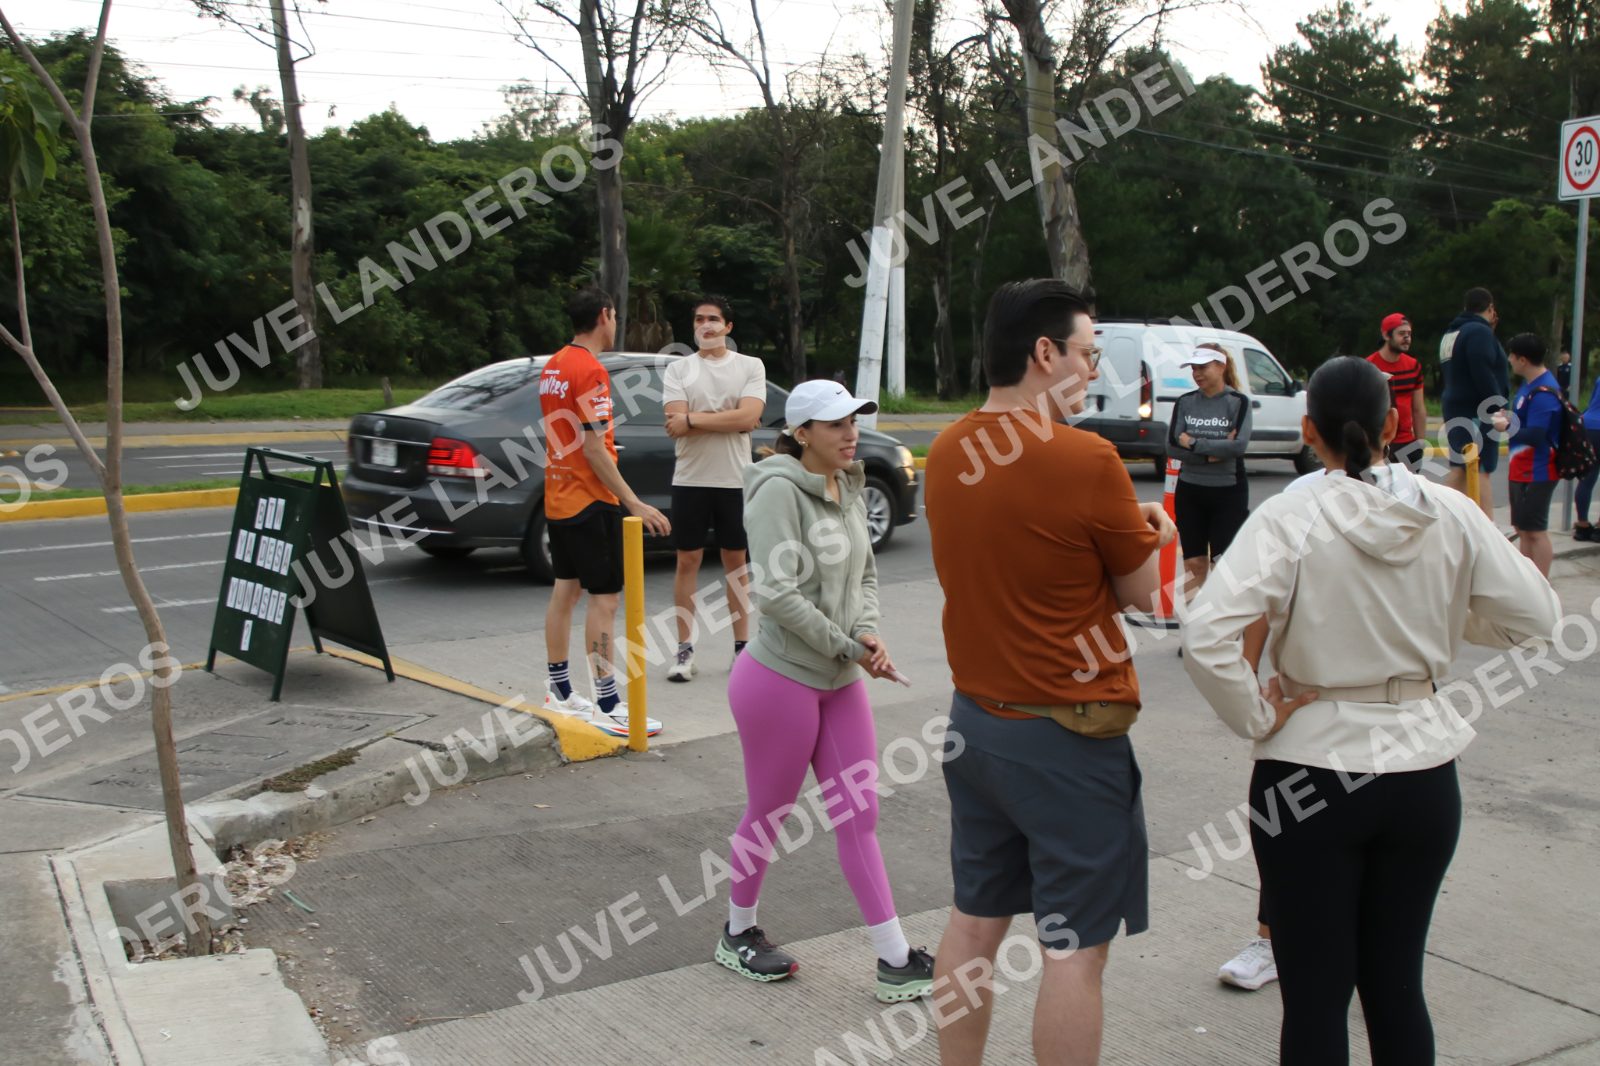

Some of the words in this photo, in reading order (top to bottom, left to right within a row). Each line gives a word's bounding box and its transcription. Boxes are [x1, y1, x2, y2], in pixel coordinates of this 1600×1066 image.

[1575, 140, 1593, 167] 30
[257, 537, 292, 574] DESA
[227, 578, 287, 624] YUNASTE
